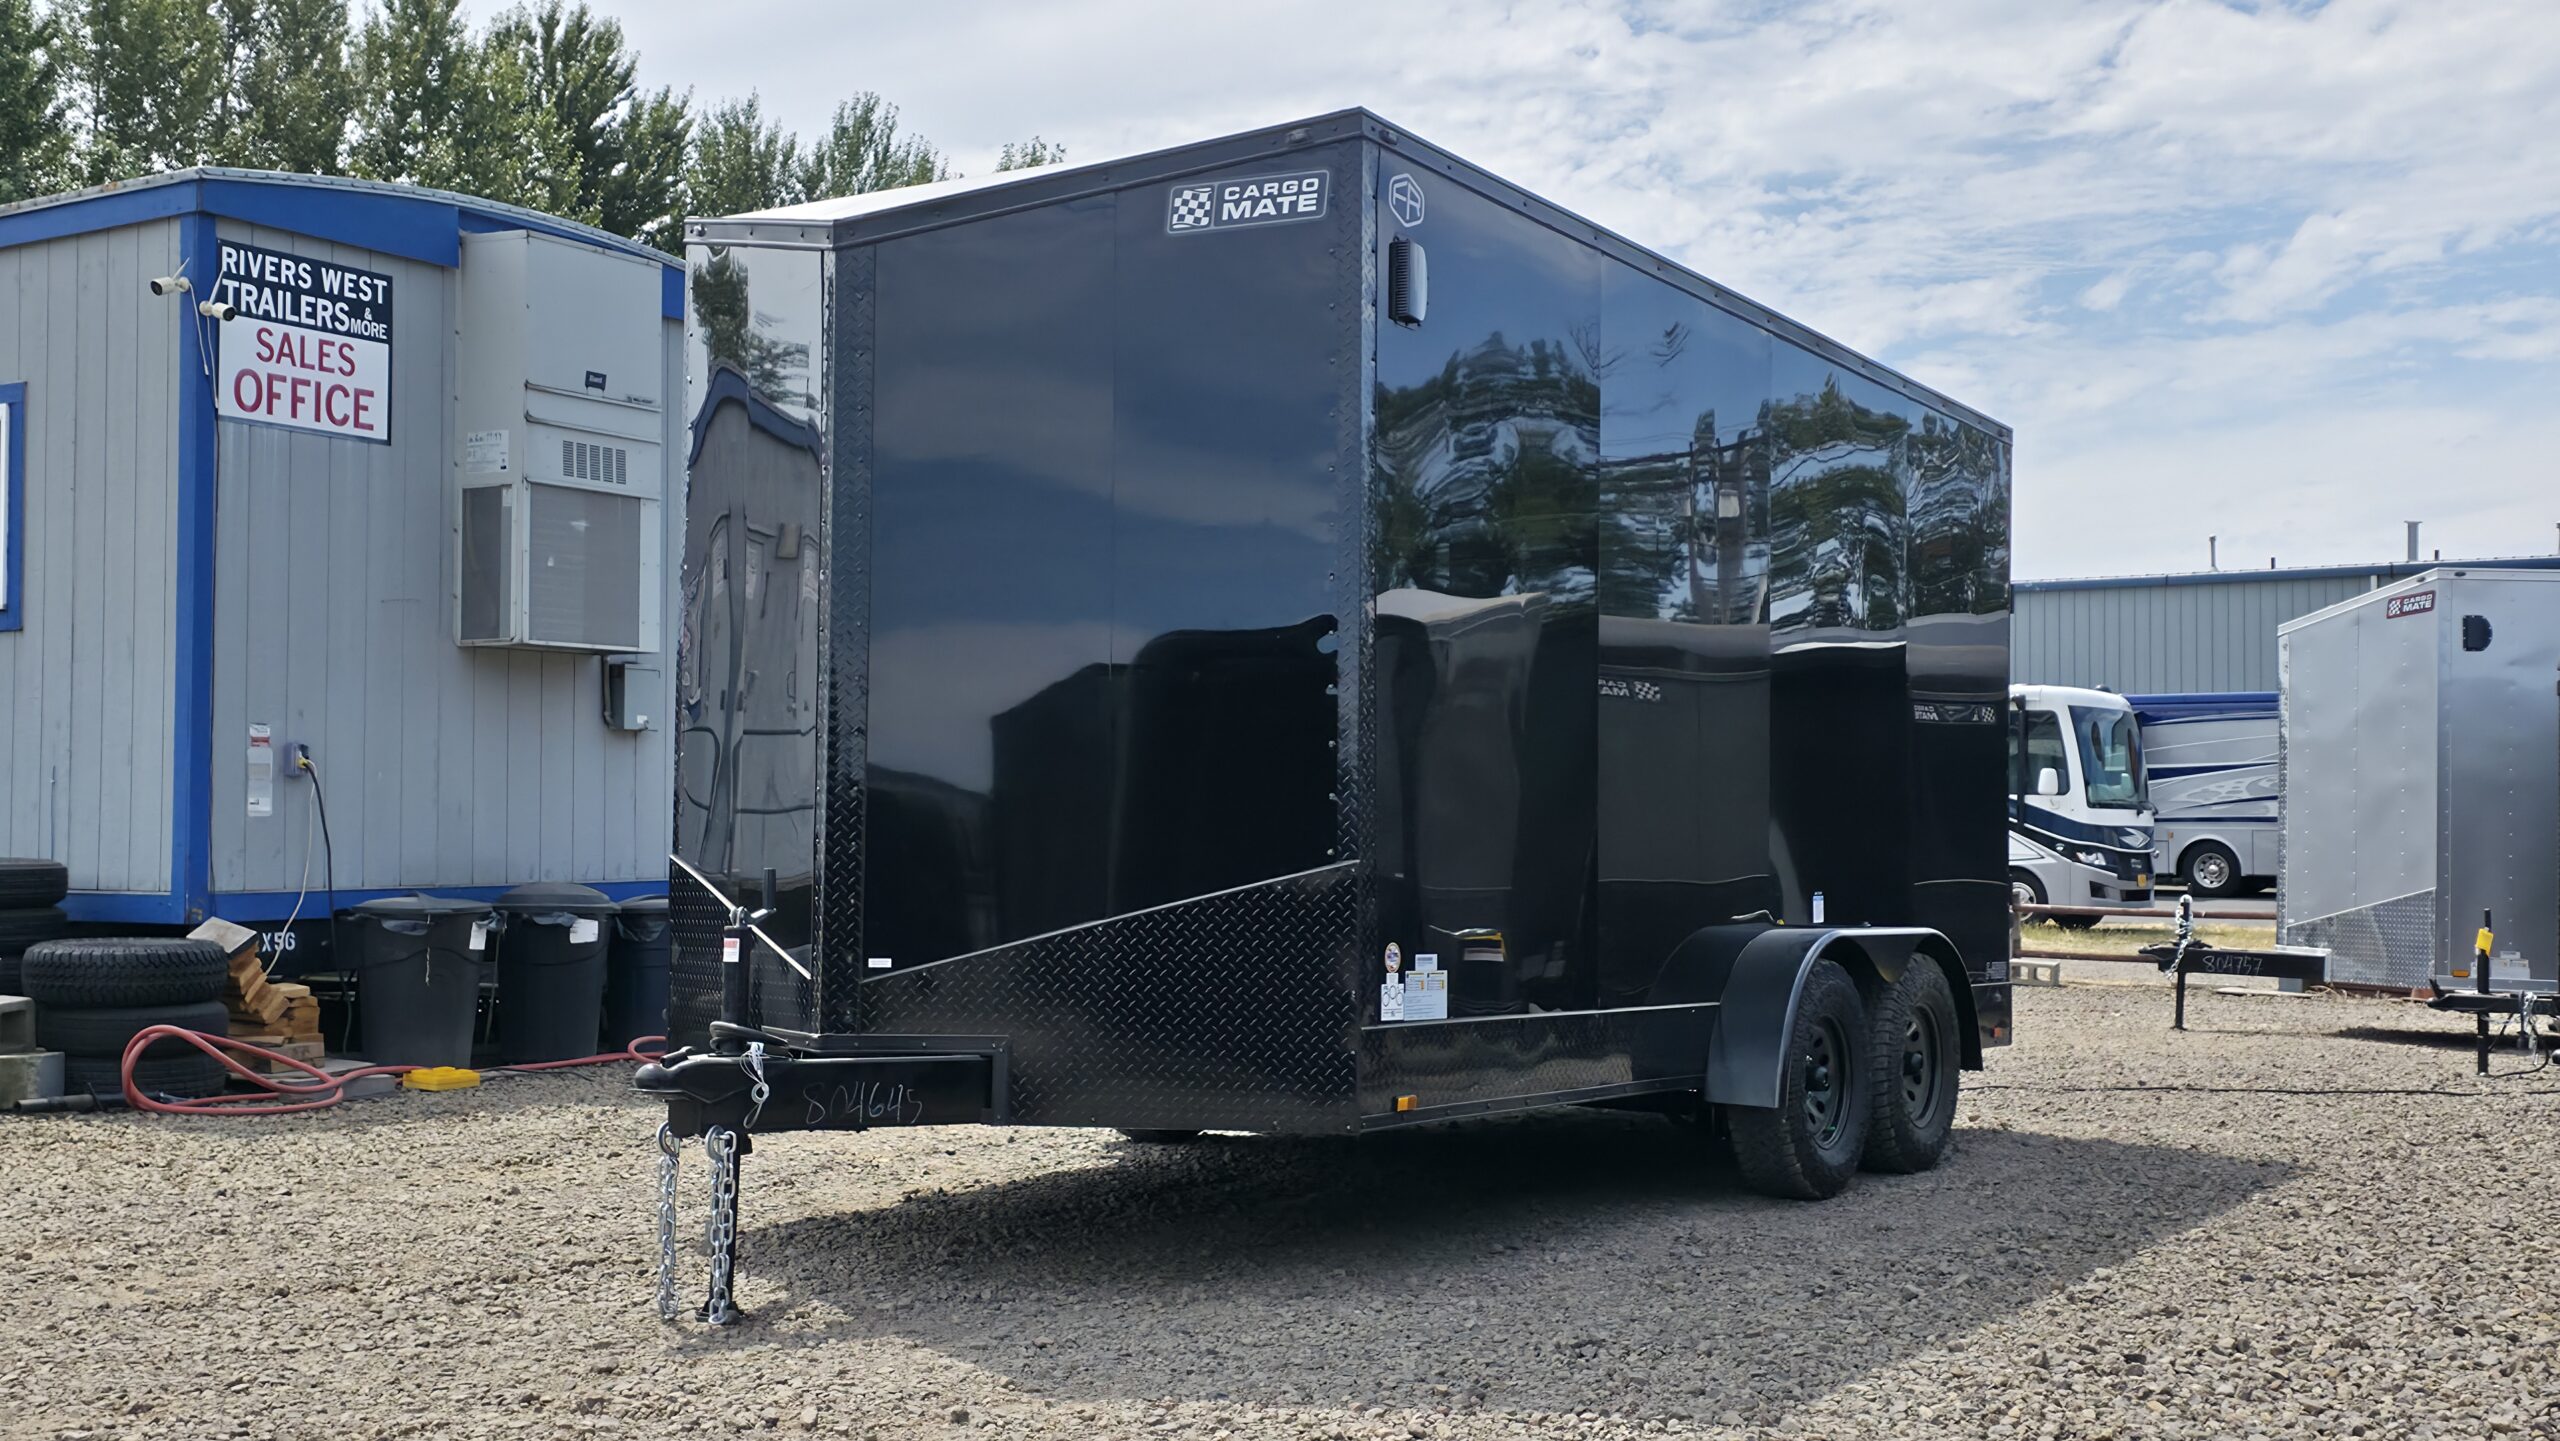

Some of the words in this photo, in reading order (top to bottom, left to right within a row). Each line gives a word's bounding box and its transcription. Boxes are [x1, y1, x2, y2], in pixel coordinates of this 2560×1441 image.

[1224, 177, 1319, 200] CARGO
[1221, 193, 1318, 221] MATE
[221, 245, 312, 290] RIVERS
[321, 267, 388, 304] WEST
[221, 278, 350, 332] TRAILERS
[364, 307, 373, 321] &
[350, 317, 388, 339] MORE
[256, 327, 356, 377] SALES
[233, 368, 375, 431] OFFICE
[2402, 600, 2432, 612] MATE
[2202, 955, 2264, 976] 804757
